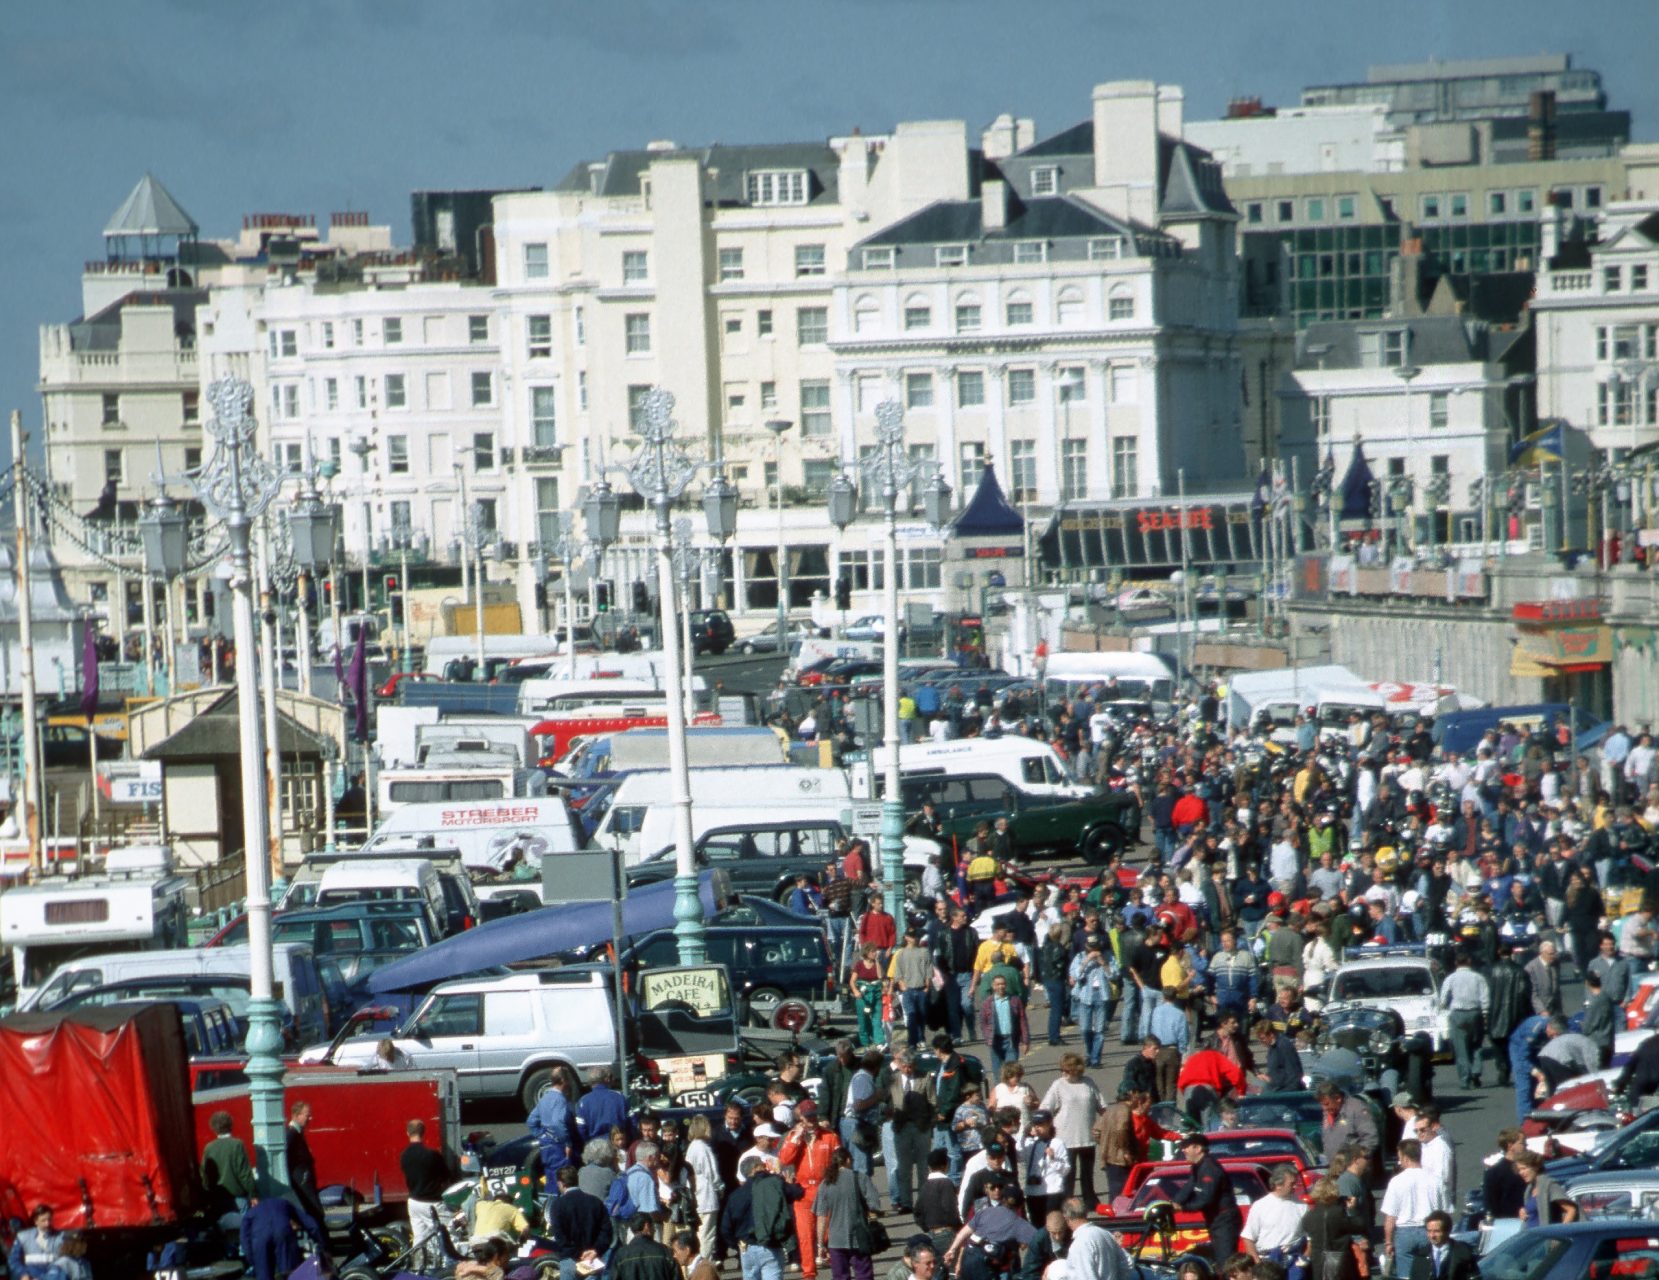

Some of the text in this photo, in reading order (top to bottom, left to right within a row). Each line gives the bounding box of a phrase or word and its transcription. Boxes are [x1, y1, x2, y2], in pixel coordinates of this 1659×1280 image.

[442, 807, 538, 819] STREBER
[441, 816, 538, 826] MOTORSPORT
[651, 975, 714, 996] MADEIRA
[667, 988, 701, 1001] CAFE
[680, 1091, 711, 1108] 159
